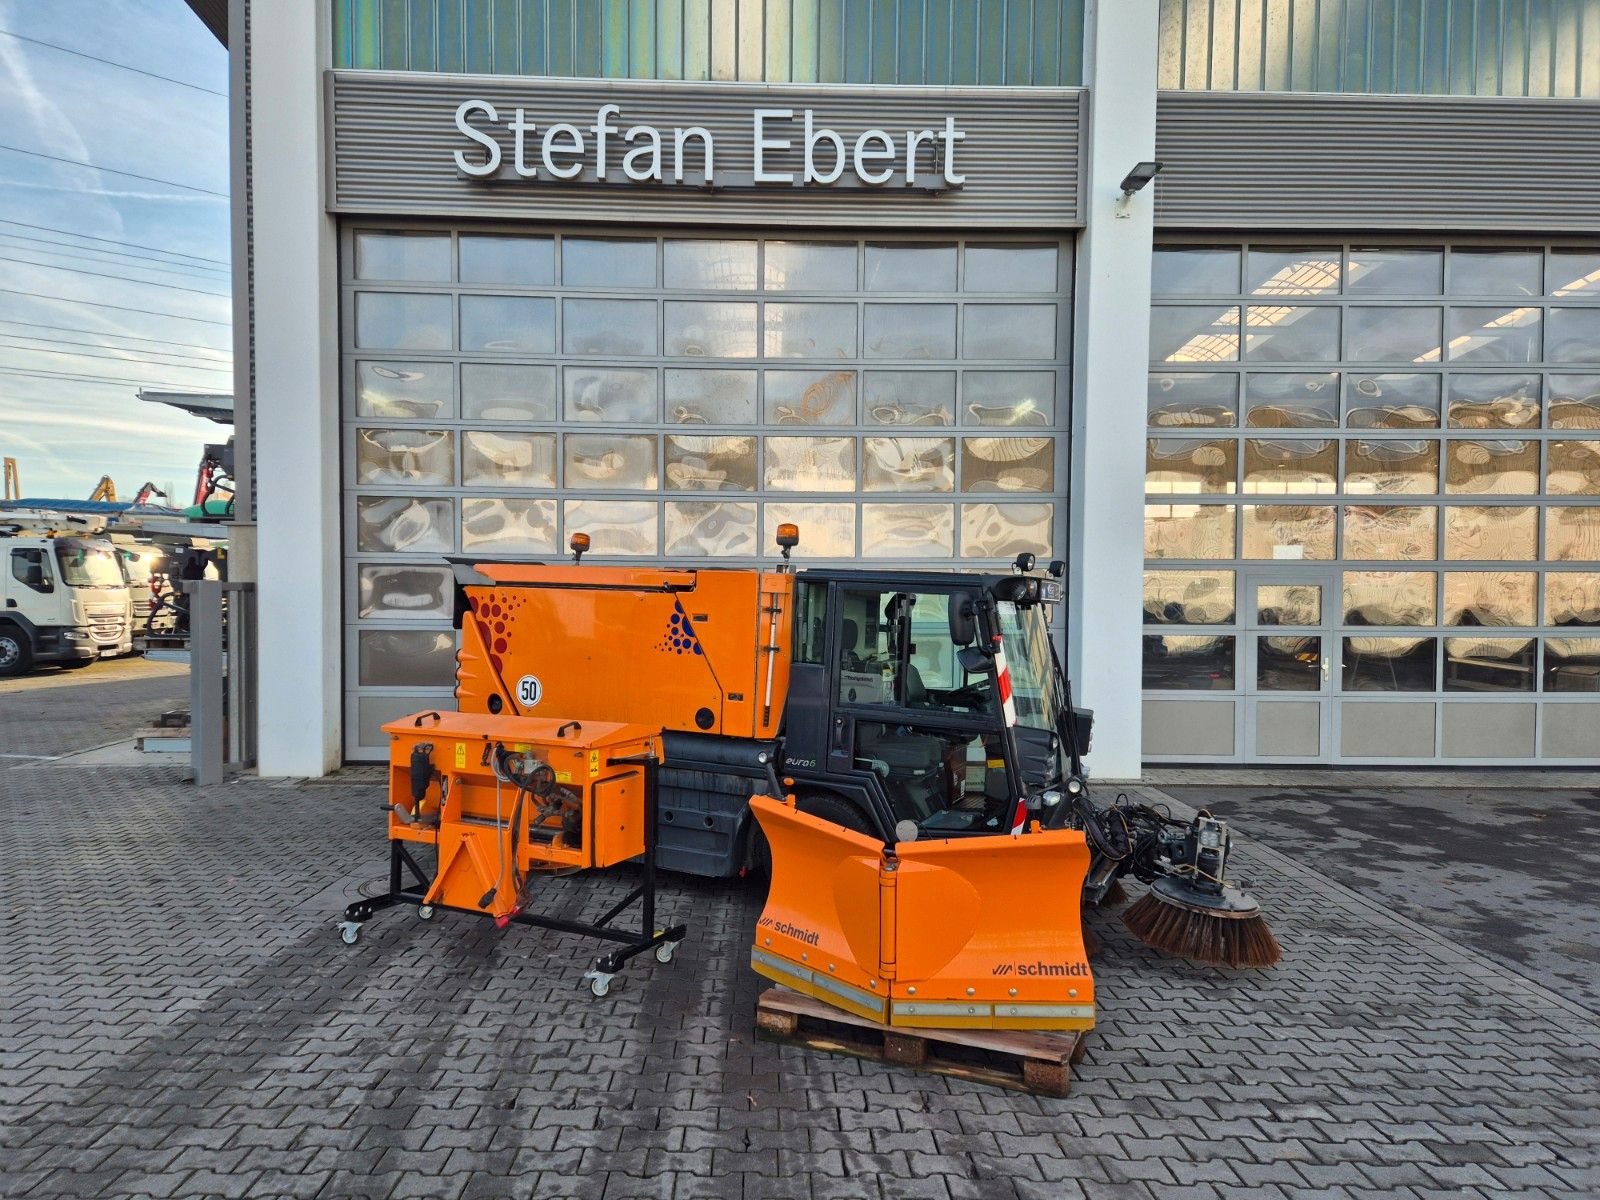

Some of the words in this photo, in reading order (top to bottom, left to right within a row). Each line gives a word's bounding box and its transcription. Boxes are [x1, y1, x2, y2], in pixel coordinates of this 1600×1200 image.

[453, 99, 715, 185] Stefan
[753, 108, 966, 186] Ebert
[521, 680, 537, 701] 50
[785, 757, 817, 768] euro6
[774, 921, 820, 947] schmidt
[1017, 961, 1089, 977] schmidt
